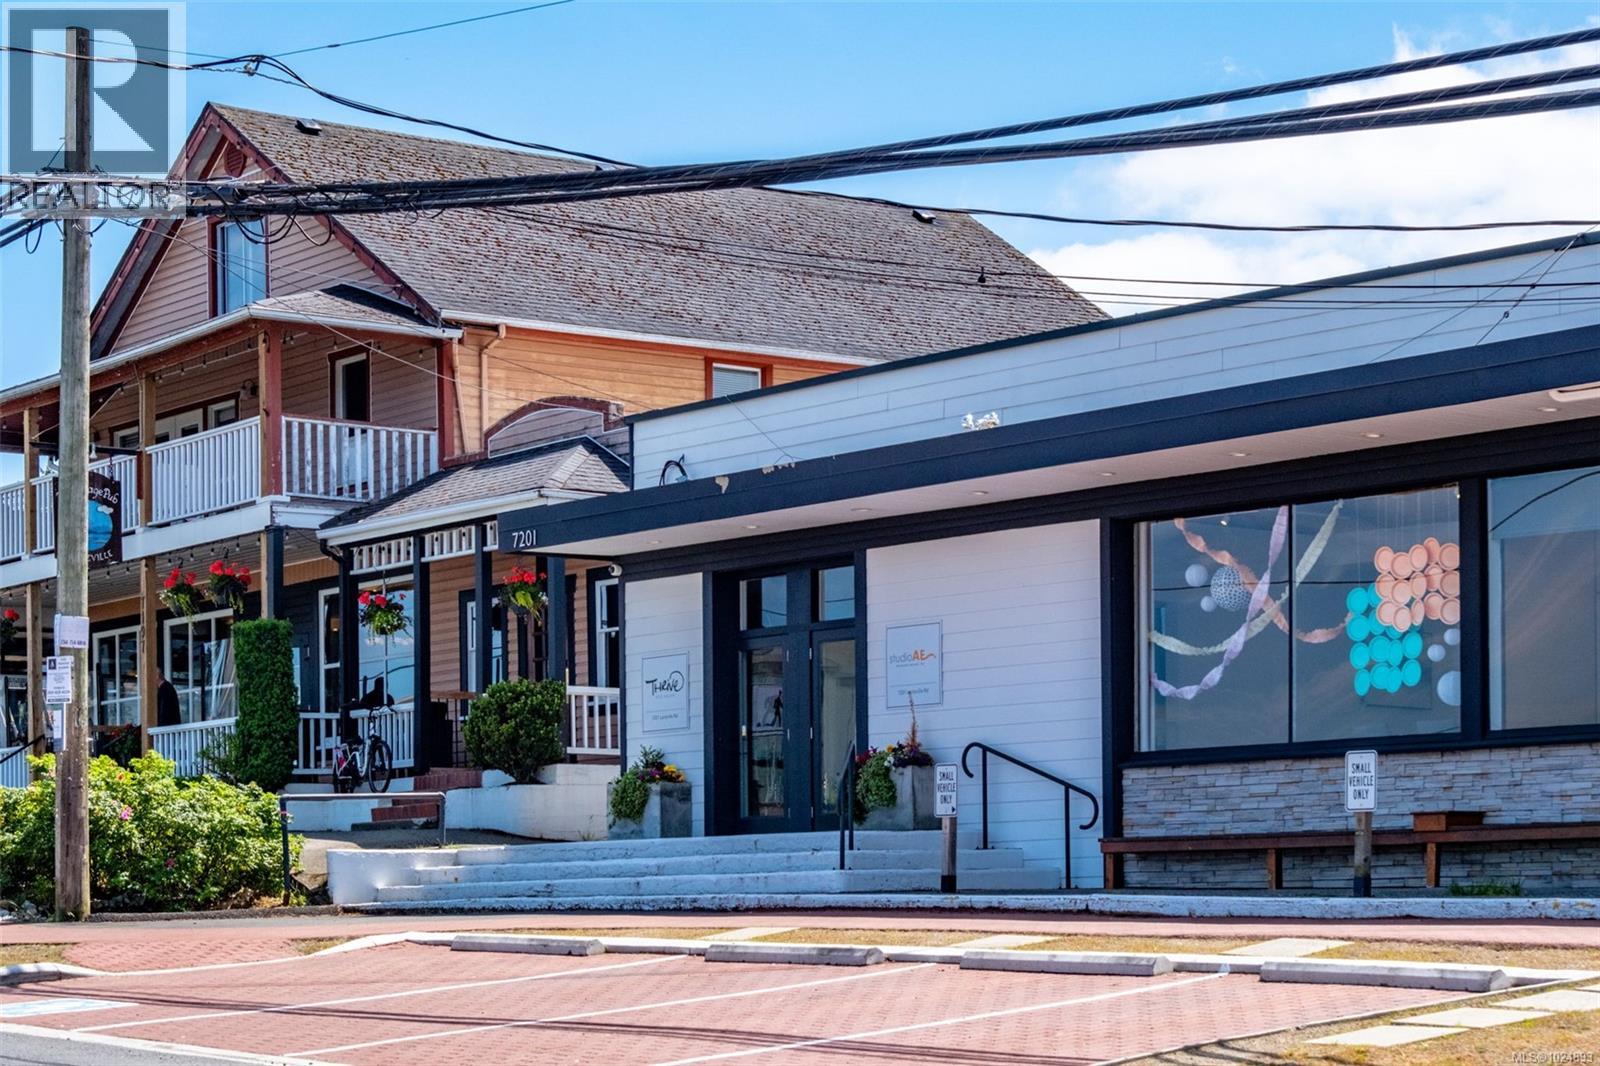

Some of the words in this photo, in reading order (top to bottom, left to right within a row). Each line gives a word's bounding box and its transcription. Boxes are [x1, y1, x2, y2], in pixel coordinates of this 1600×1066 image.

[512, 529, 536, 548] 7201
[1351, 762, 1372, 774] SMALL
[938, 771, 954, 781] SMALL
[1349, 775, 1374, 787] VEHICLE
[937, 782, 956, 792] VEHICLE
[940, 794, 953, 805] ONLY
[1352, 788, 1370, 800] ONLY
